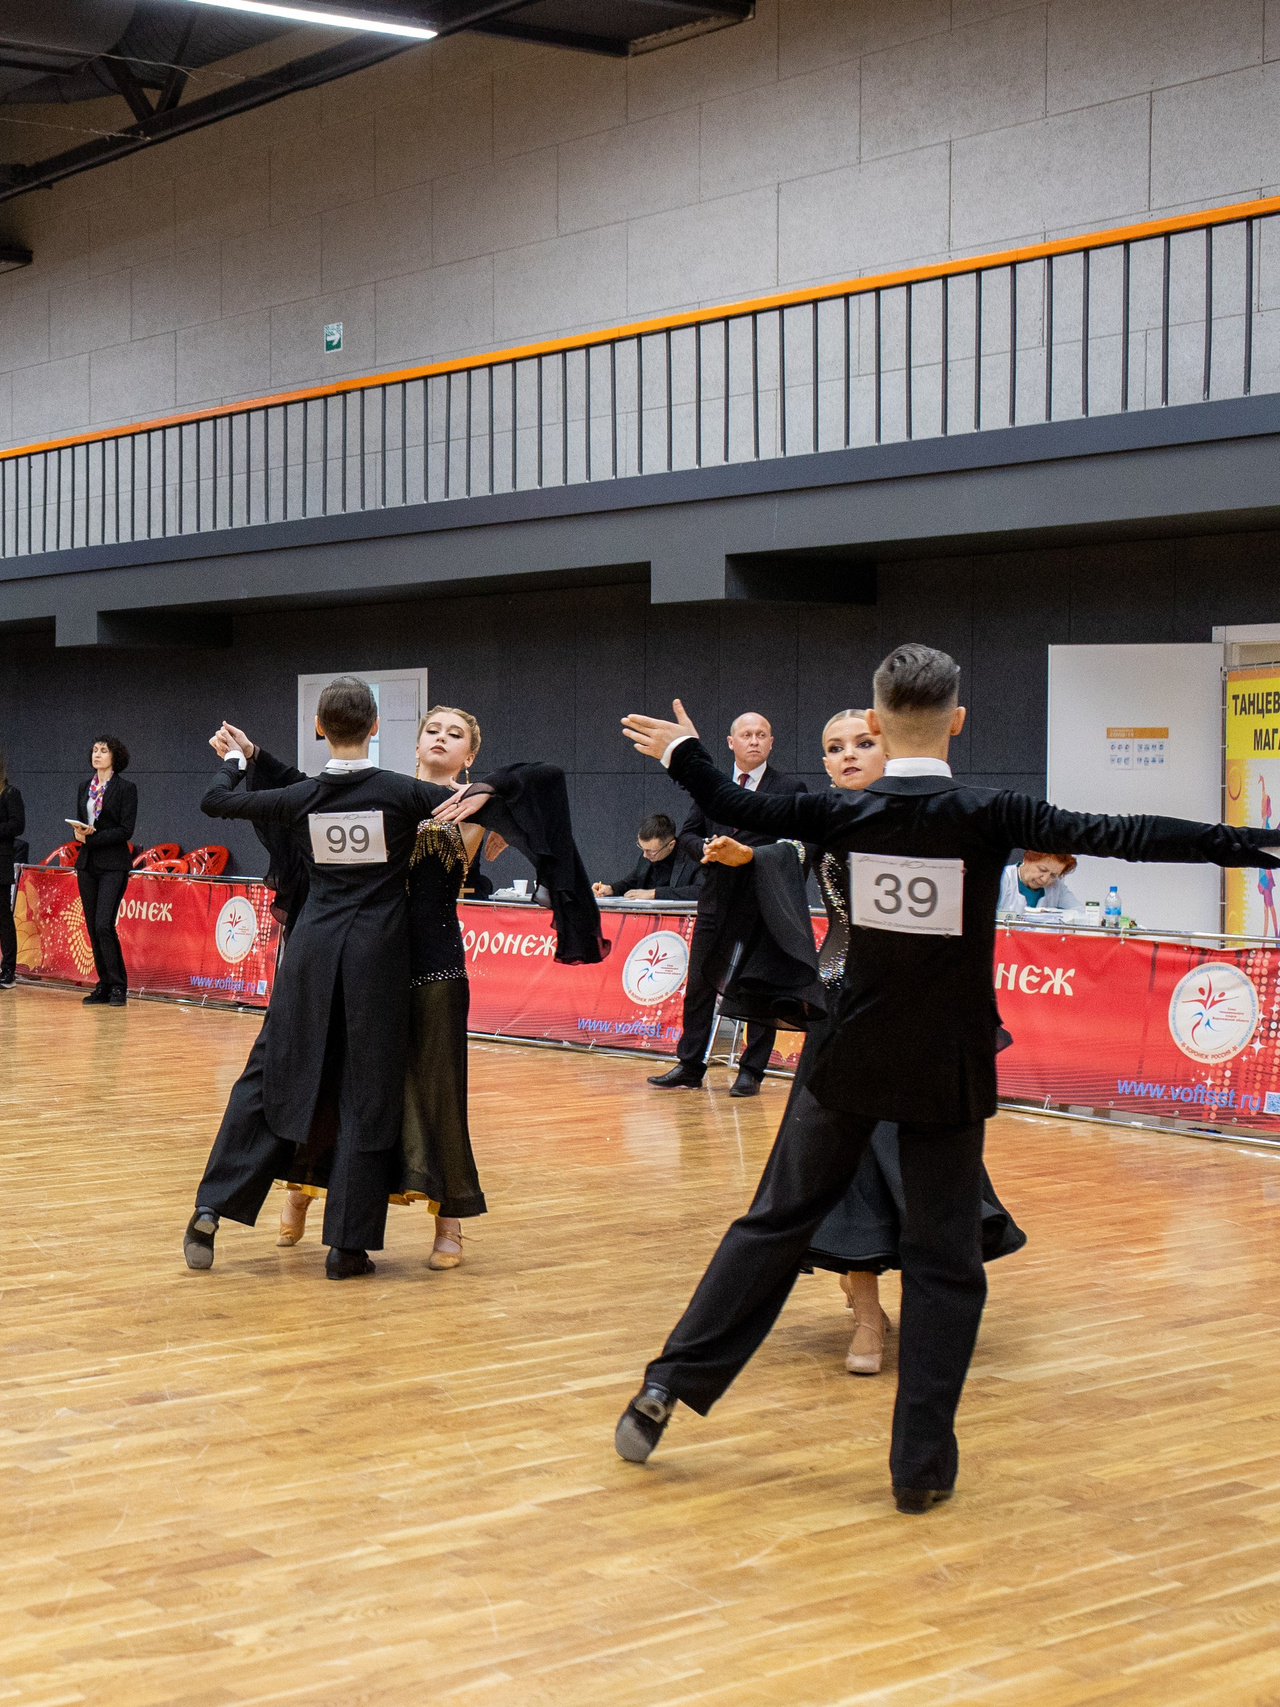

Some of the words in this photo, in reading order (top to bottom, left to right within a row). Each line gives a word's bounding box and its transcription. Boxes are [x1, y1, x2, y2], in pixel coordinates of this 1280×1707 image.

[1232, 691, 1280, 719] ТАНЦЕВ
[326, 824, 370, 854] 99
[874, 873, 938, 918] 39
[577, 1017, 681, 1040] www.voftsst.ru
[1117, 1079, 1261, 1111] www.voftsst.ru
